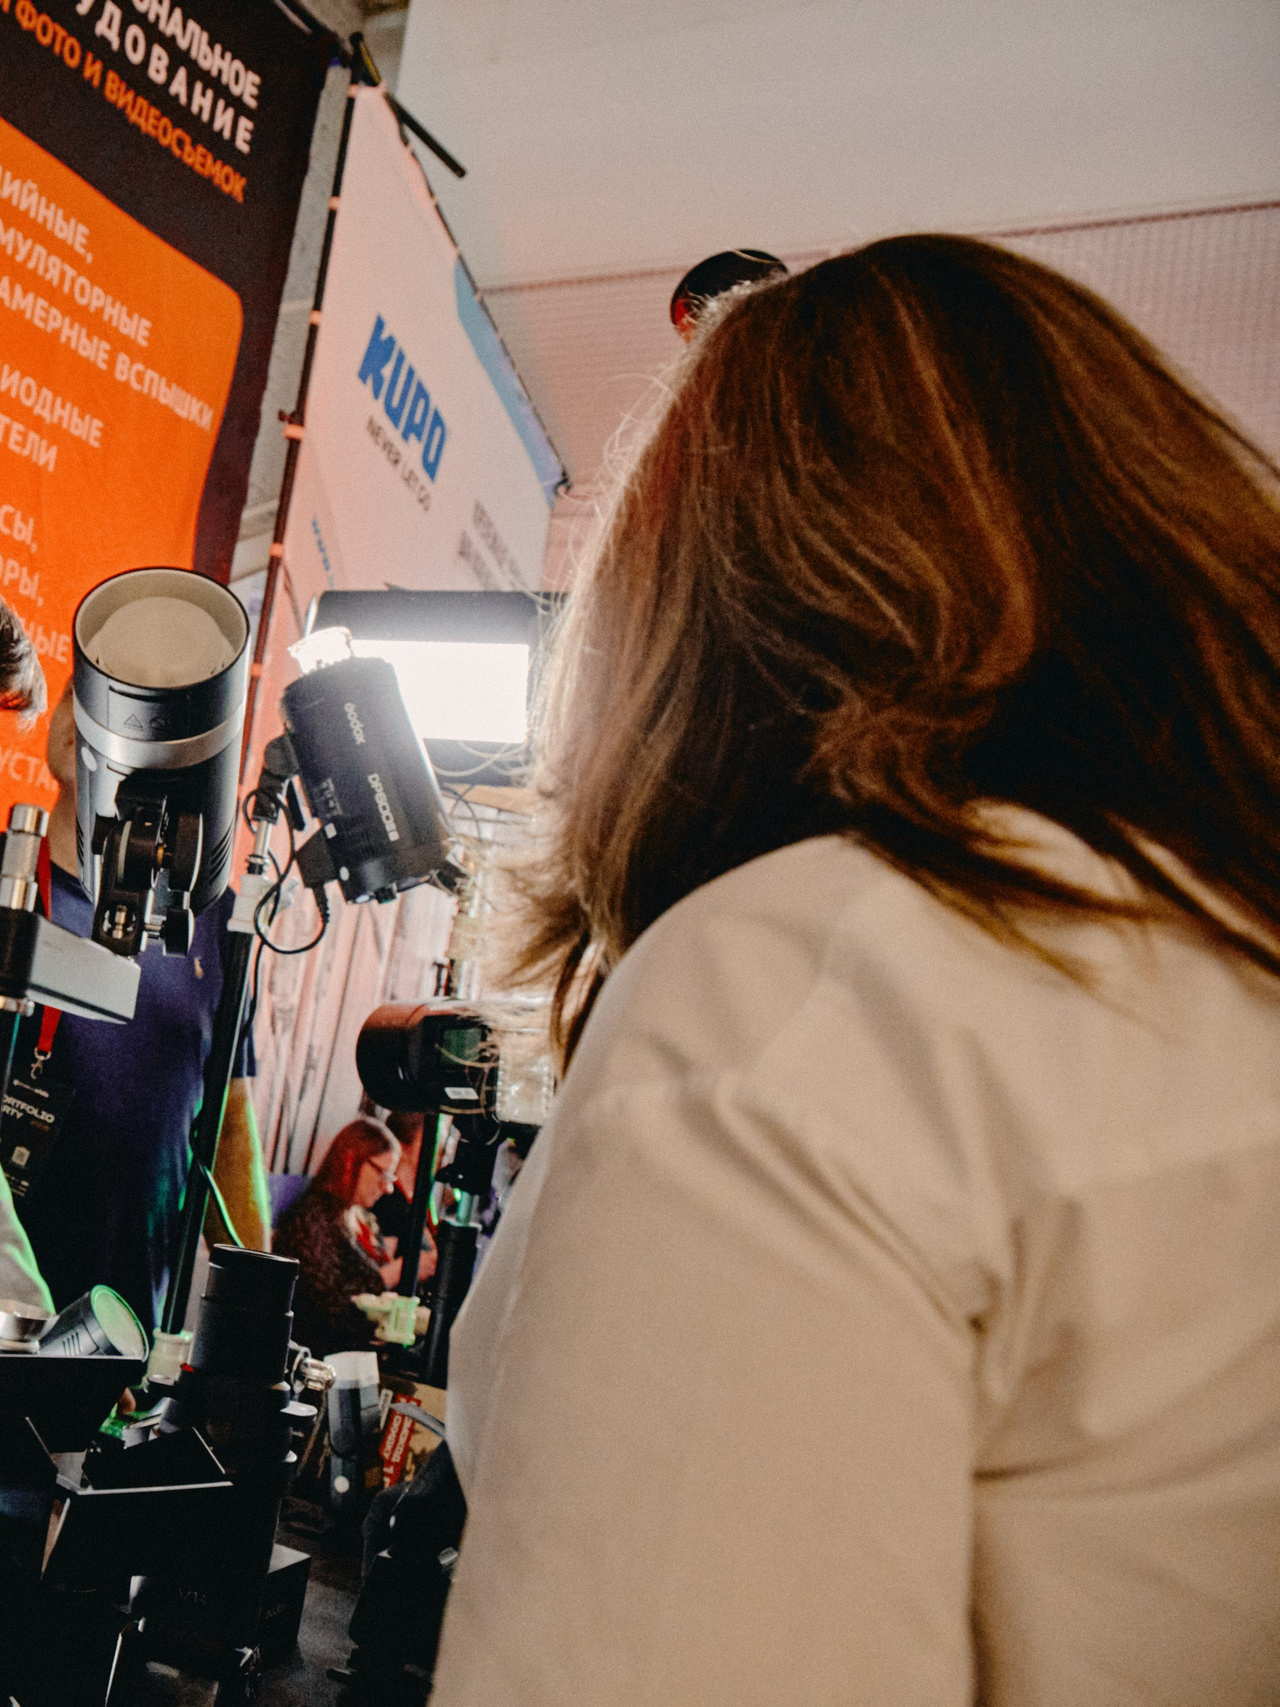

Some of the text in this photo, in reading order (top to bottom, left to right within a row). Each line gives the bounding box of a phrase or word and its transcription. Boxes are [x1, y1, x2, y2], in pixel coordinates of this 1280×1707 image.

[15, 0, 81, 68] ФОТО
[83, 51, 103, 88] И
[115, 352, 213, 432] ВСПЫШКИ
[358, 312, 447, 484] KUPO
[3, 1094, 55, 1124] ORTFOLIO
